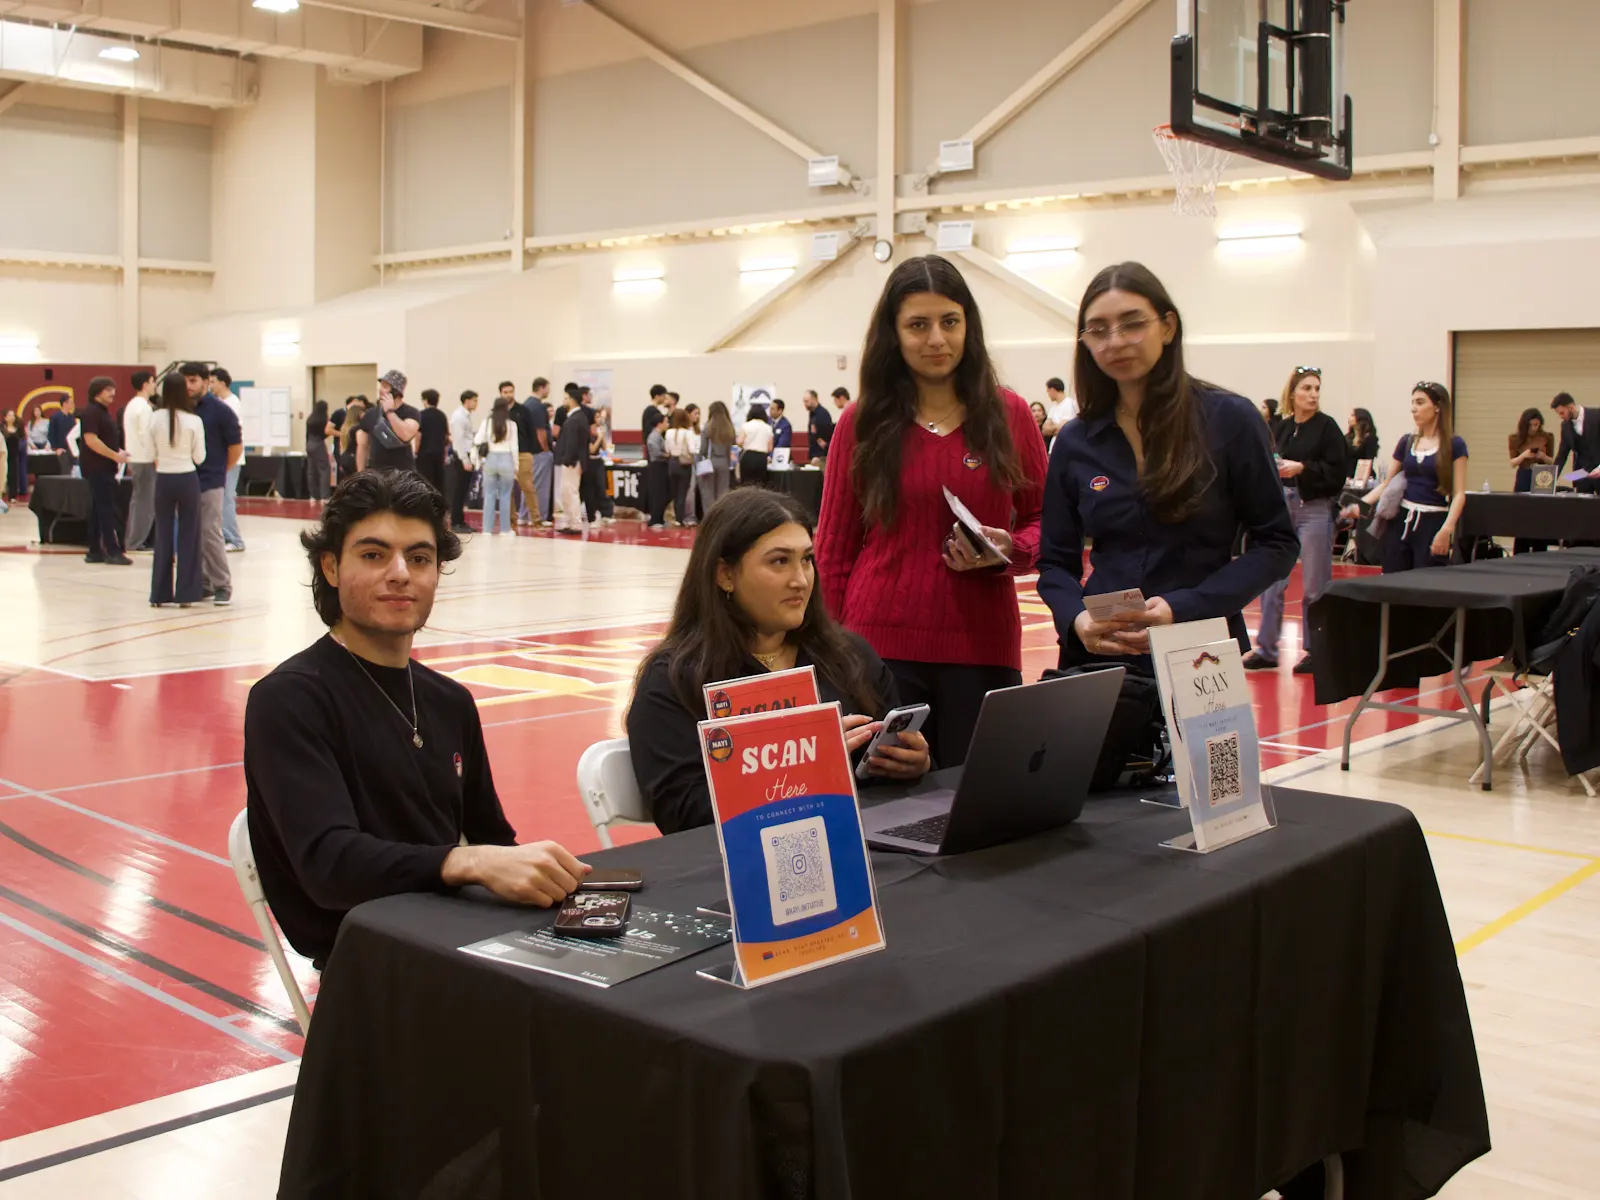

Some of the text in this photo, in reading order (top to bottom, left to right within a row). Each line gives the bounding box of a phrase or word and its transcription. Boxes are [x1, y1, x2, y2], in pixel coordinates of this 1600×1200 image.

[1193, 671, 1229, 697] SCAN
[1203, 695, 1226, 714] Here
[712, 739, 728, 749] NAYI
[741, 735, 818, 775] SCAN
[765, 773, 808, 801] Here
[767, 807, 796, 819] CONNECT
[798, 803, 814, 812] WITH
[625, 928, 657, 939] Us
